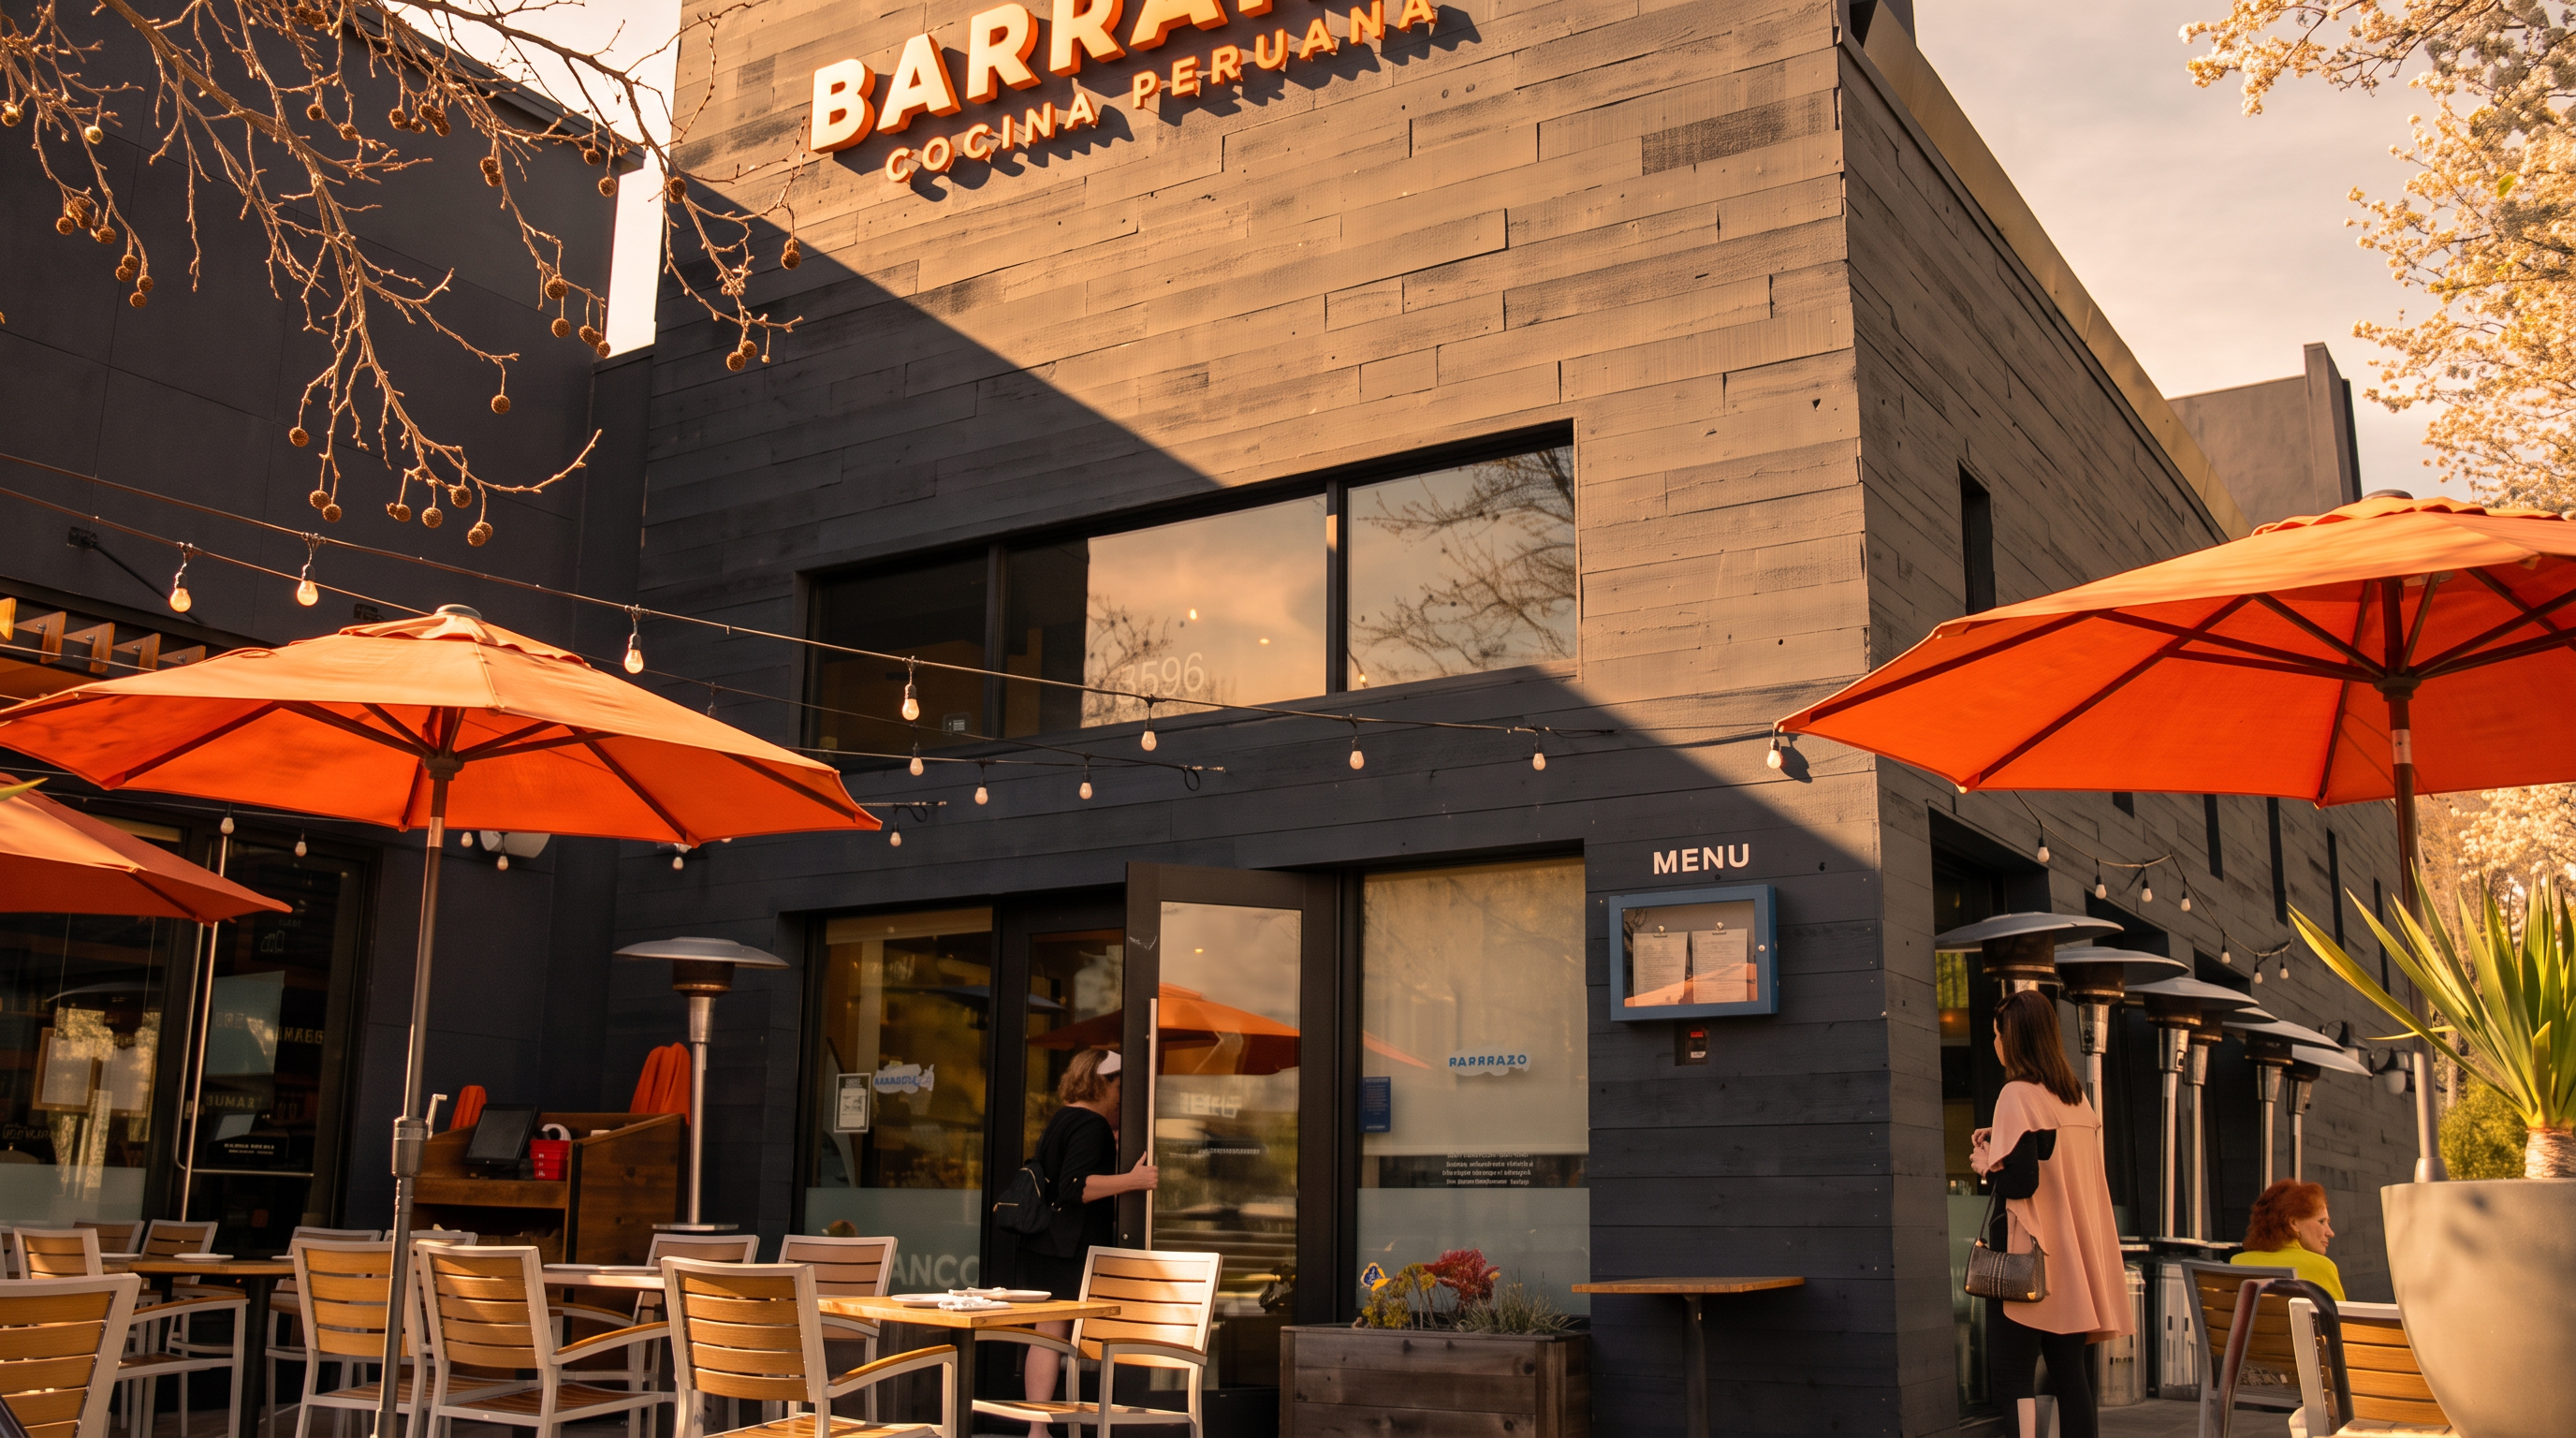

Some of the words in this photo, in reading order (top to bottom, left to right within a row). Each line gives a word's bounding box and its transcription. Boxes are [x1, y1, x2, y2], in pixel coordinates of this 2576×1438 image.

[809, 0, 1273, 154] BARRA
[884, 92, 1100, 183] COCINA
[1132, 0, 1439, 110] PERUANA
[1116, 652, 1205, 705] 3596
[1653, 843, 1749, 874] MENU
